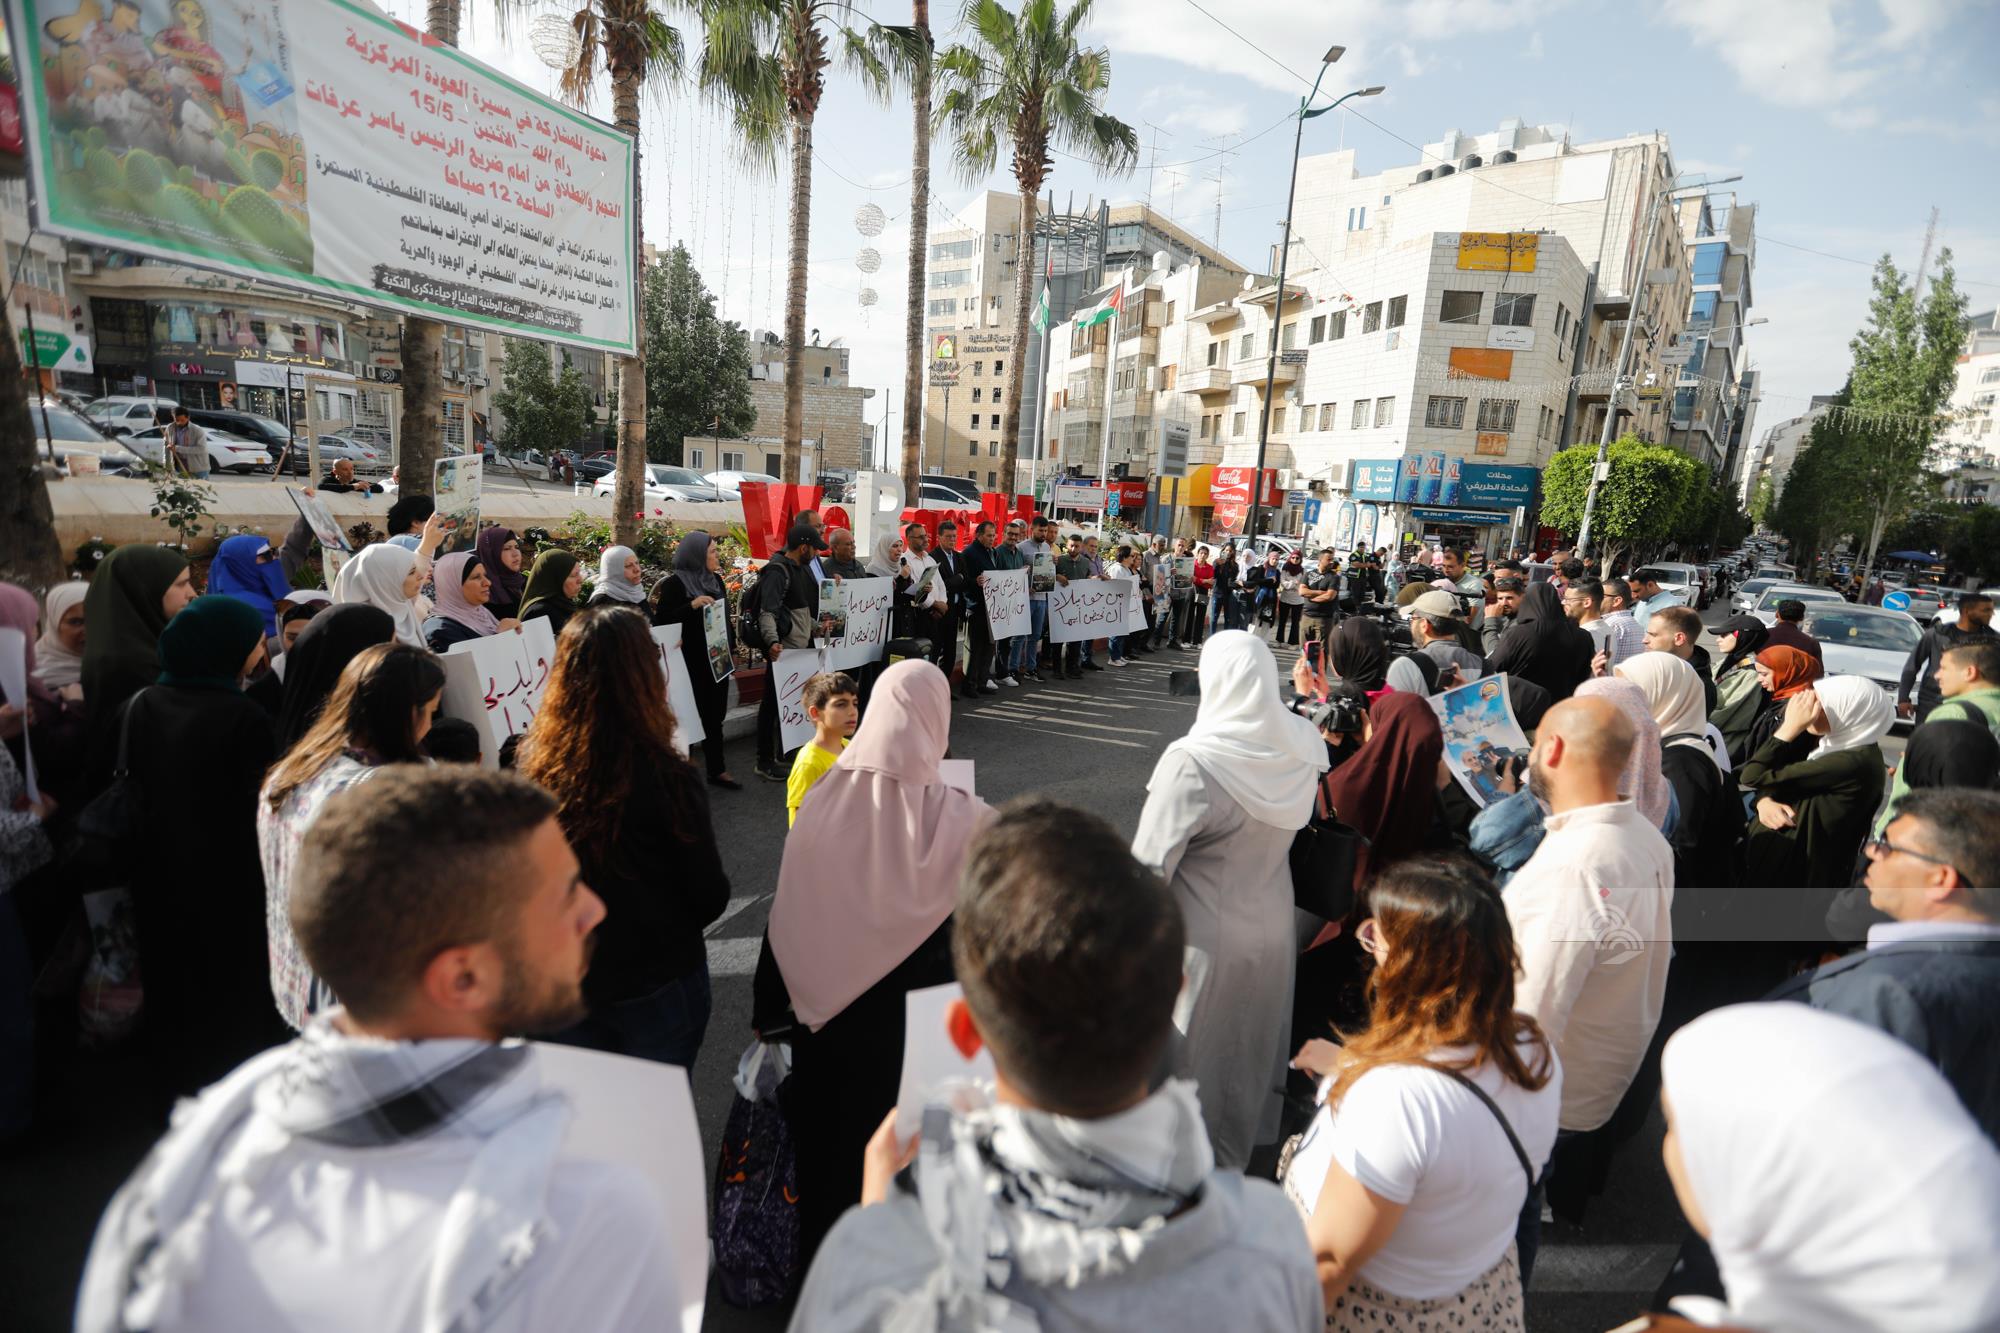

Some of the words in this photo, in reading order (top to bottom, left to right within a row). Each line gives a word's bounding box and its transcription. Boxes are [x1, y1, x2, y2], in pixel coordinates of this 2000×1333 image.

[346, 27, 420, 77] المركزية
[425, 64, 468, 99] العودة
[305, 79, 362, 118] عرفات
[410, 89, 454, 122] 15/5
[472, 86, 512, 119] مسيرة
[367, 111, 405, 140] ياسر
[516, 111, 532, 134] في
[535, 115, 583, 151] للمشاركة
[411, 130, 465, 158] الرئيس
[532, 145, 552, 163] الله
[586, 141, 607, 162] دعوة
[315, 153, 363, 183] المستمرة
[469, 147, 504, 174] ضريح
[554, 155, 572, 177] رام
[445, 165, 486, 195] صباحا
[508, 163, 530, 183] أمام
[366, 171, 426, 203] الفلسطينية
[489, 181, 511, 203] 12
[534, 175, 550, 192] من
[429, 193, 468, 222] بالمعاناة
[514, 190, 554, 219] الساعة
[595, 199, 621, 218] التجمع
[401, 215, 443, 240] بمأساتهم
[520, 224, 543, 243] المتحدة
[400, 238, 436, 265] والحرية
[497, 243, 518, 258] العالم
[556, 239, 566, 256] في
[438, 255, 464, 272] الوجود
[466, 259, 477, 279] في
[382, 271, 411, 290] النكبة
[478, 264, 517, 284] الفلسطيني
[518, 275, 540, 290] الشعب
[574, 266, 594, 283] النكبة
[595, 271, 613, 288] ضحايا
[411, 282, 434, 297] ذكرى
[457, 290, 478, 307] العليا
[558, 285, 576, 301] عدوان
[577, 290, 597, 306] النكبة
[478, 295, 503, 313] الوطنية
[503, 302, 521, 318] اللجنة
[169, 362, 203, 375] K&M
[1218, 469, 1242, 485] Coca-Cola
[1358, 467, 1372, 487] XL
[1405, 460, 1420, 477] XL
[1424, 457, 1442, 477] XL
[1446, 463, 1460, 480] XL
[1486, 472, 1512, 480] محلات
[1465, 481, 1500, 493] الطريفي
[1500, 484, 1529, 493] شحادة
[876, 595, 888, 610] من
[1054, 588, 1081, 612] ميلاد
[1106, 592, 1124, 606] من
[1106, 602, 1122, 623] أن
